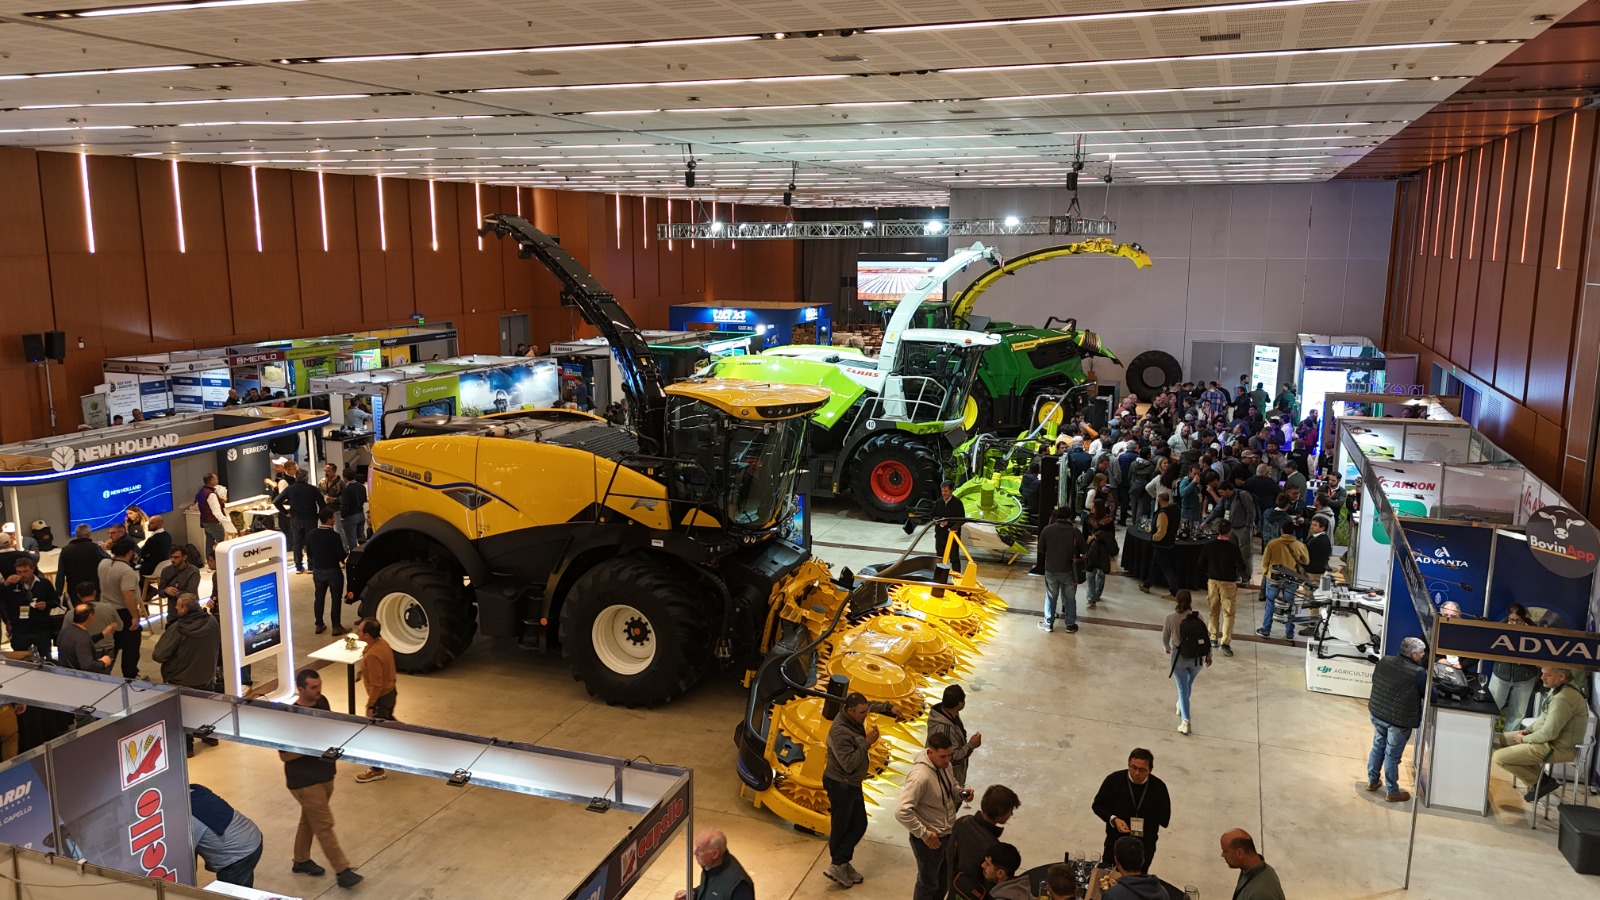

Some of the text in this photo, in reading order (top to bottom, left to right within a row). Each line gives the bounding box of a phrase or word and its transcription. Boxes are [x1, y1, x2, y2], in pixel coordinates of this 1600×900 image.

[243, 353, 277, 364] MERLO
[846, 367, 880, 378] CLAAS
[867, 421, 876, 429] 40
[78, 433, 179, 462] NEW HOLLAND
[242, 444, 268, 456] FERRERO
[393, 466, 421, 481] HOLLAND
[121, 484, 142, 493] HOLLAND
[1392, 481, 1437, 492] AKRON
[243, 547, 260, 558] CNH
[1529, 534, 1596, 563] BovinApp
[1415, 556, 1469, 568] ADVANTA
[1489, 634, 1600, 661] ADVA
[3, 805, 33, 825] CAPELLO
